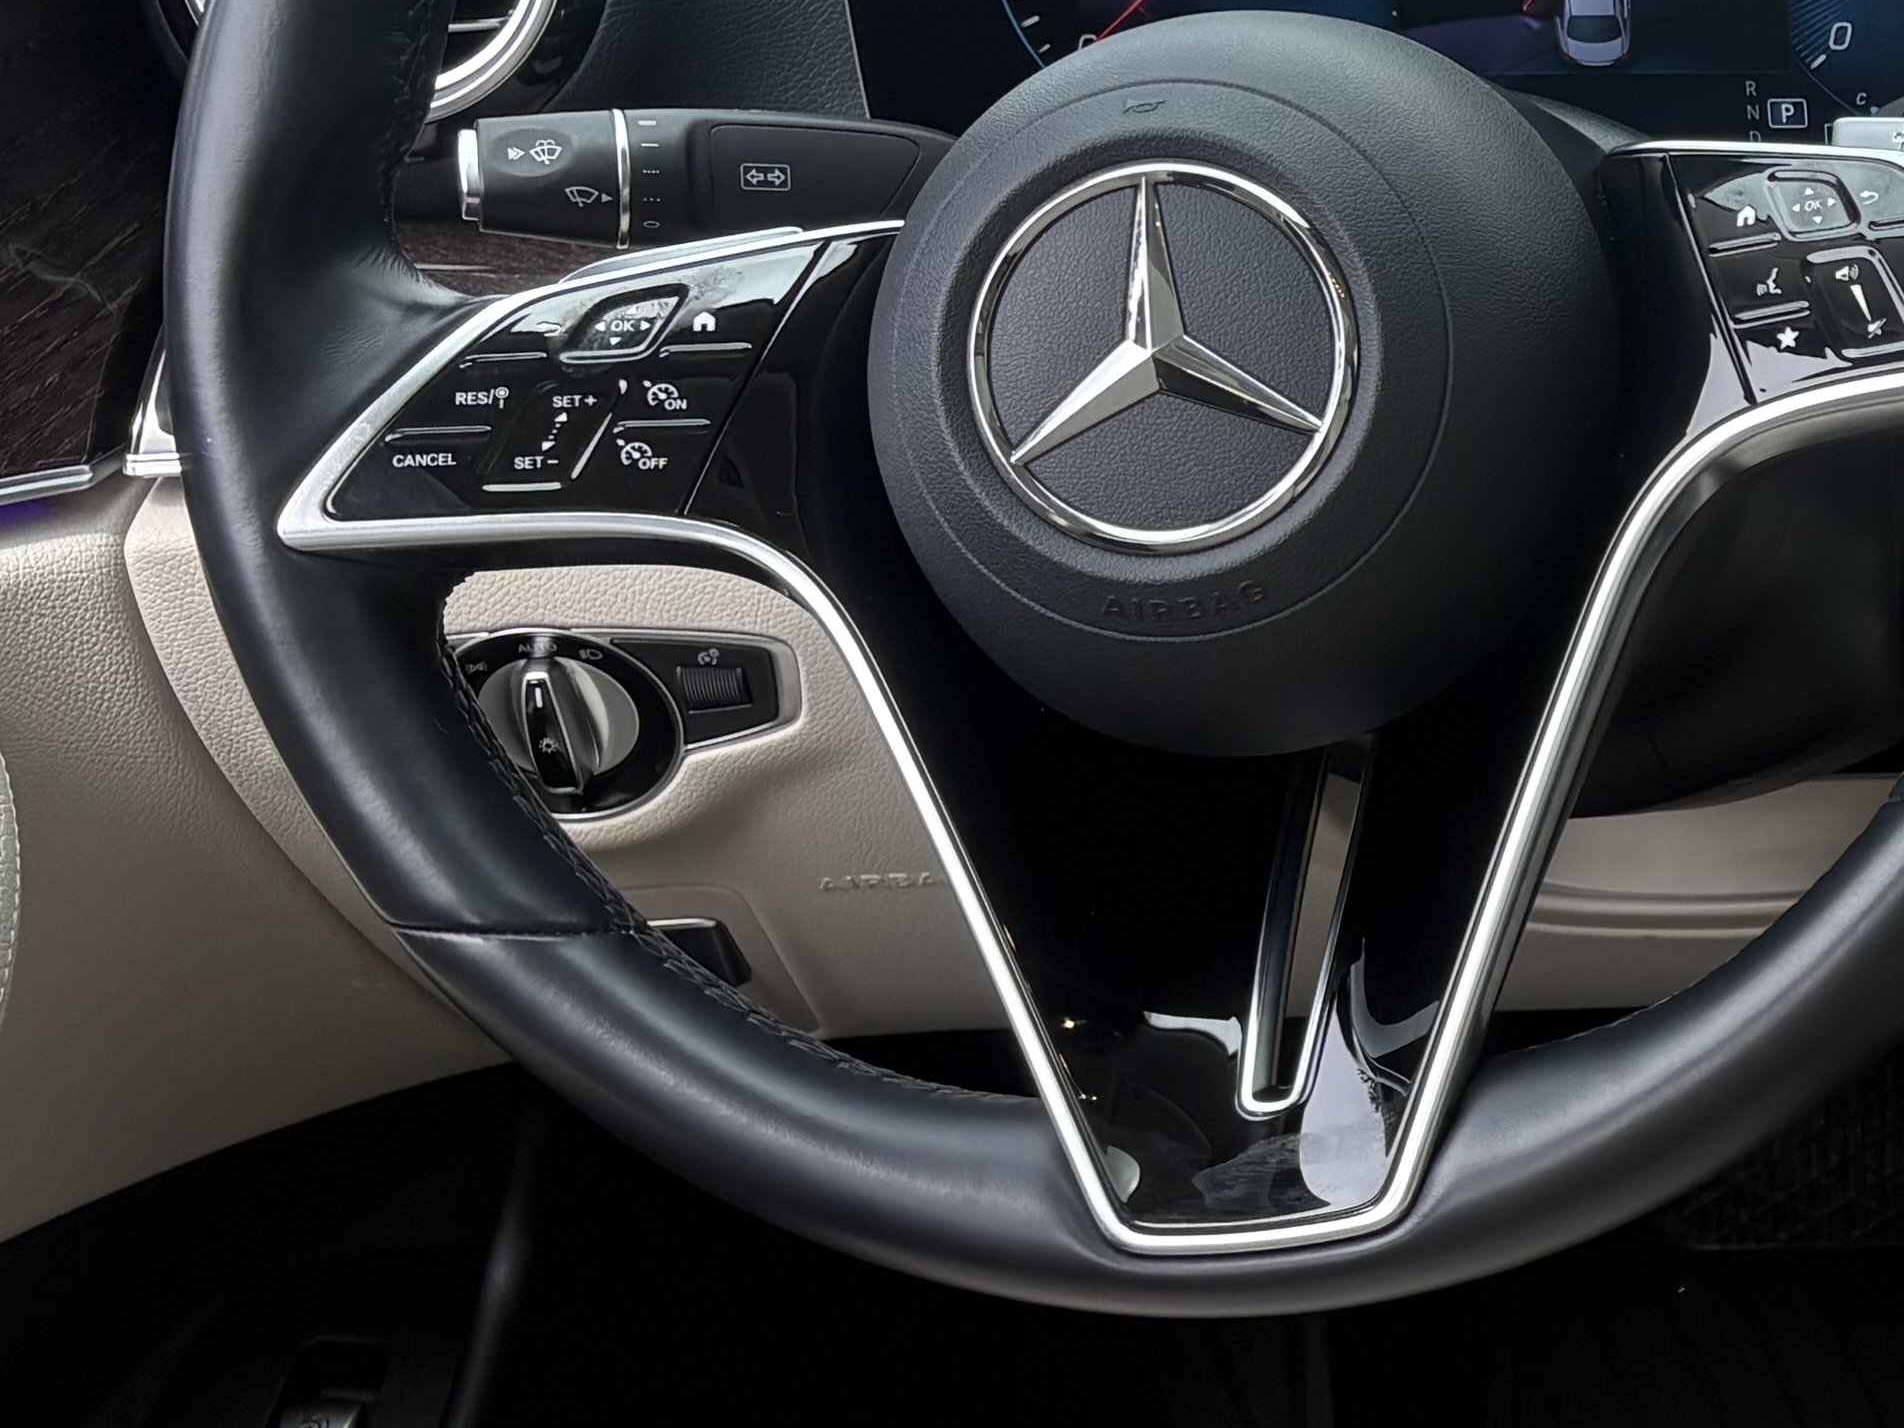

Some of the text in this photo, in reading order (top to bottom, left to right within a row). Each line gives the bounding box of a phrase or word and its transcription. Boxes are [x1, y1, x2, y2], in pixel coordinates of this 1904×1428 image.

[1828, 21, 1852, 50] 0
[1744, 80, 1758, 97] R
[1856, 92, 1867, 106] C
[1746, 103, 1761, 121] N
[1780, 103, 1795, 124] P
[1804, 198, 1823, 212] OK
[610, 320, 635, 332] OK
[664, 398, 688, 411] ON
[392, 453, 457, 469] CANCEL
[638, 457, 669, 470] OFF
[1100, 579, 1267, 622] AIRBAG
[818, 872, 946, 892] AIRBA
